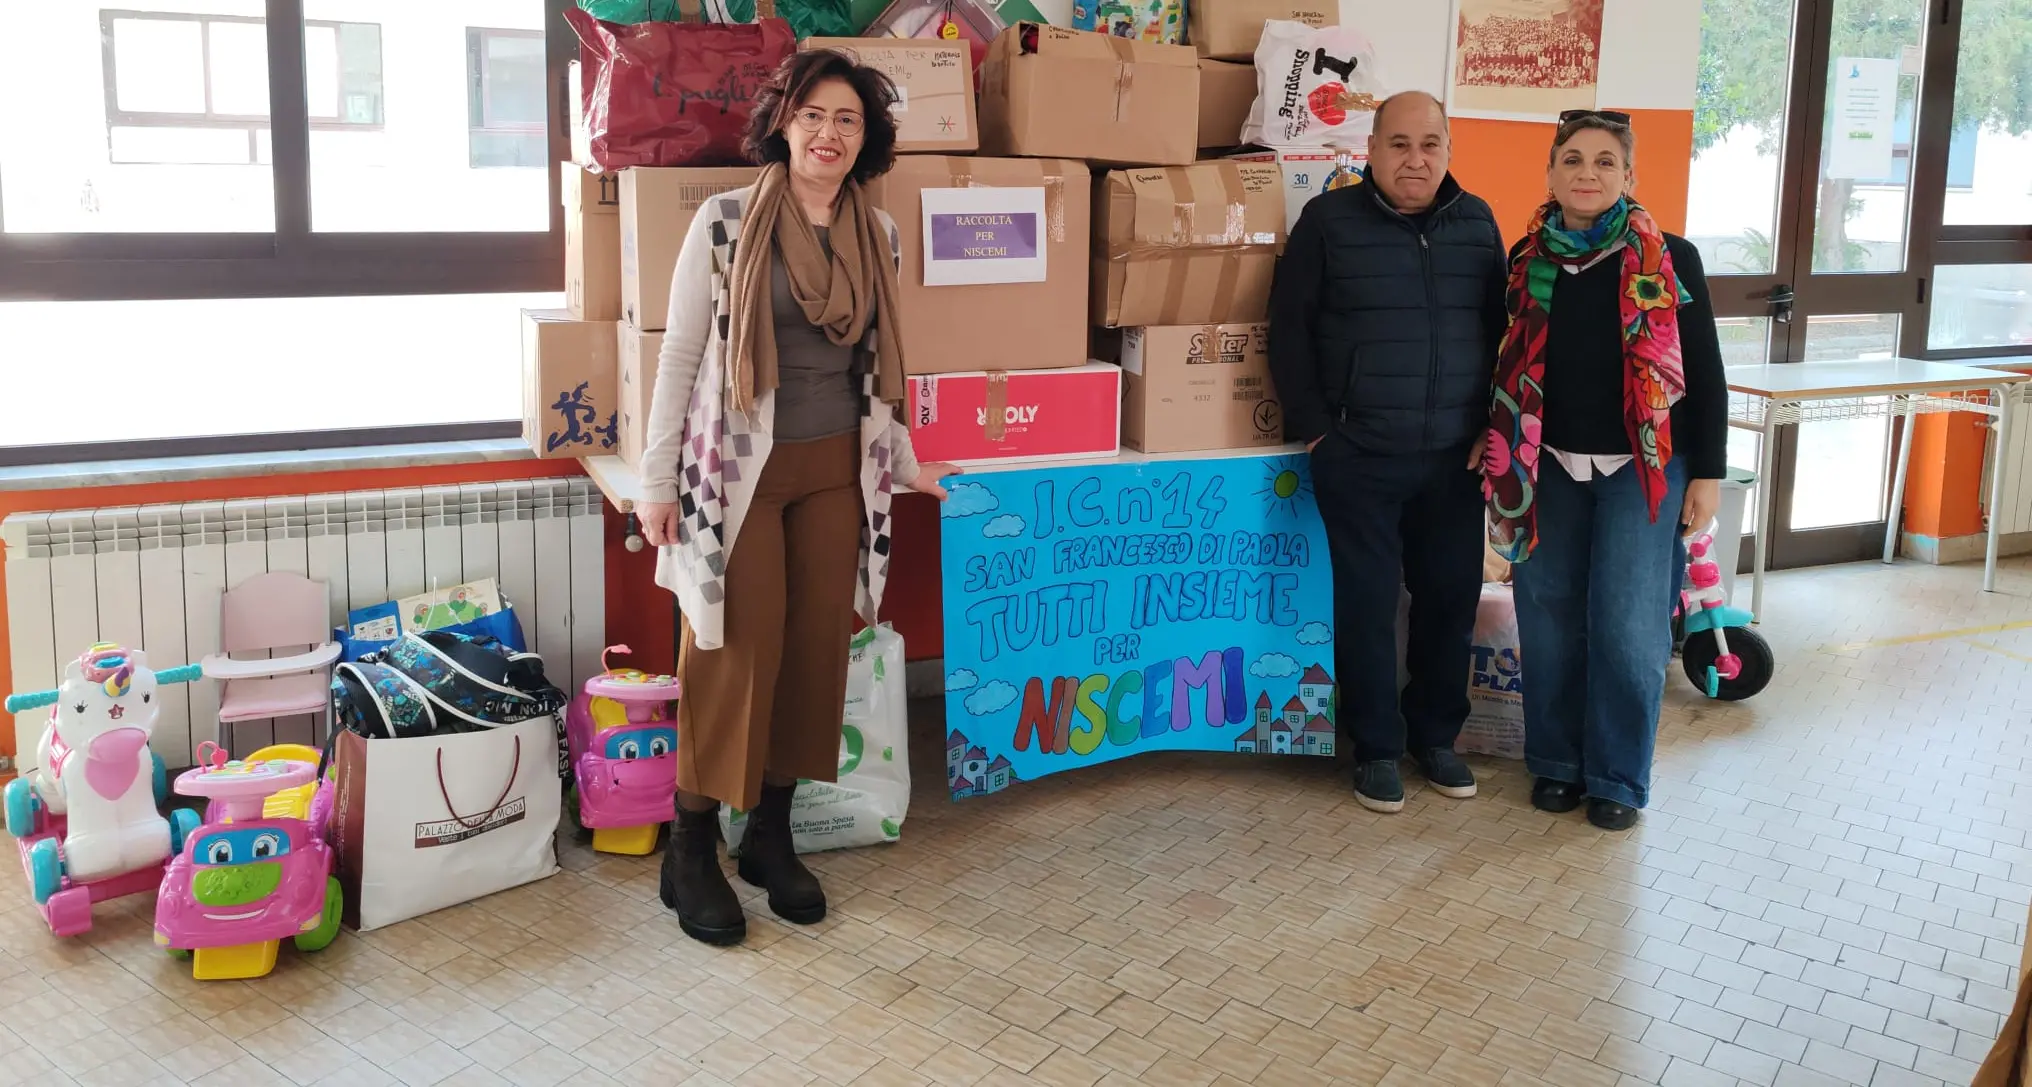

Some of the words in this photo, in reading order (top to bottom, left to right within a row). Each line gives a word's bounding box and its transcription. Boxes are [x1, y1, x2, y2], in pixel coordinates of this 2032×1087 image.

[1313, 47, 1358, 83] I
[1278, 48, 1311, 119] Shopping
[1294, 173, 1309, 185] 30
[956, 215, 1012, 226] RACCOLTA
[975, 231, 995, 241] PER
[964, 246, 1007, 258] NISCEMI
[1188, 332, 1249, 356] Ster
[964, 546, 1036, 592] SAN
[1053, 532, 1194, 574] FRANCESCO
[1197, 532, 1225, 565] DI
[1228, 530, 1310, 568] PAOLA
[965, 579, 1108, 662] TUTTI
[1130, 569, 1300, 630] INSIEME
[1094, 633, 1141, 666] PER
[1013, 646, 1248, 756] NISCEMI
[418, 821, 463, 837] PALAZZO
[496, 803, 523, 819] MODA
